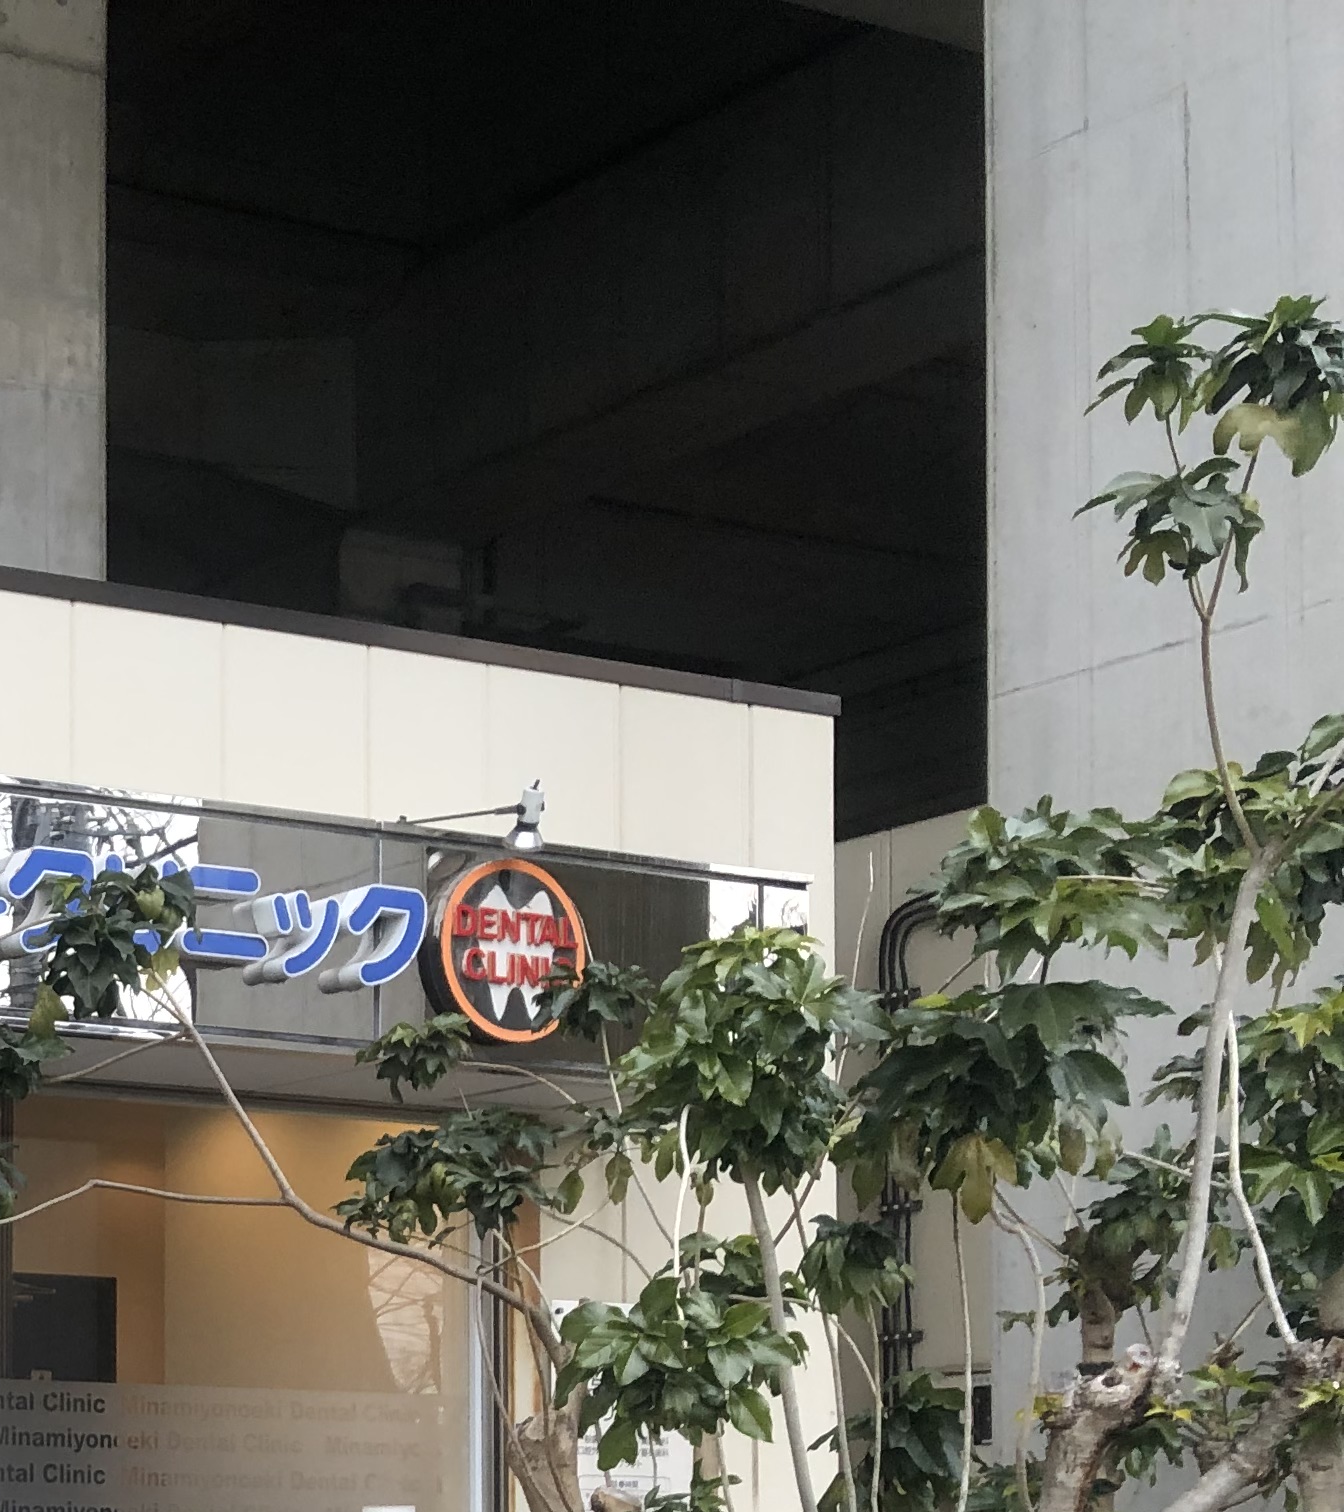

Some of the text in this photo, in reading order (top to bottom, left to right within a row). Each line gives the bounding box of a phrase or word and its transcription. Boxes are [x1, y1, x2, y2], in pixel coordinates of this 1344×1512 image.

[452, 903, 579, 950] DENTAL
[42, 1391, 106, 1414] Clinic
[42, 1462, 106, 1485] Clinic
